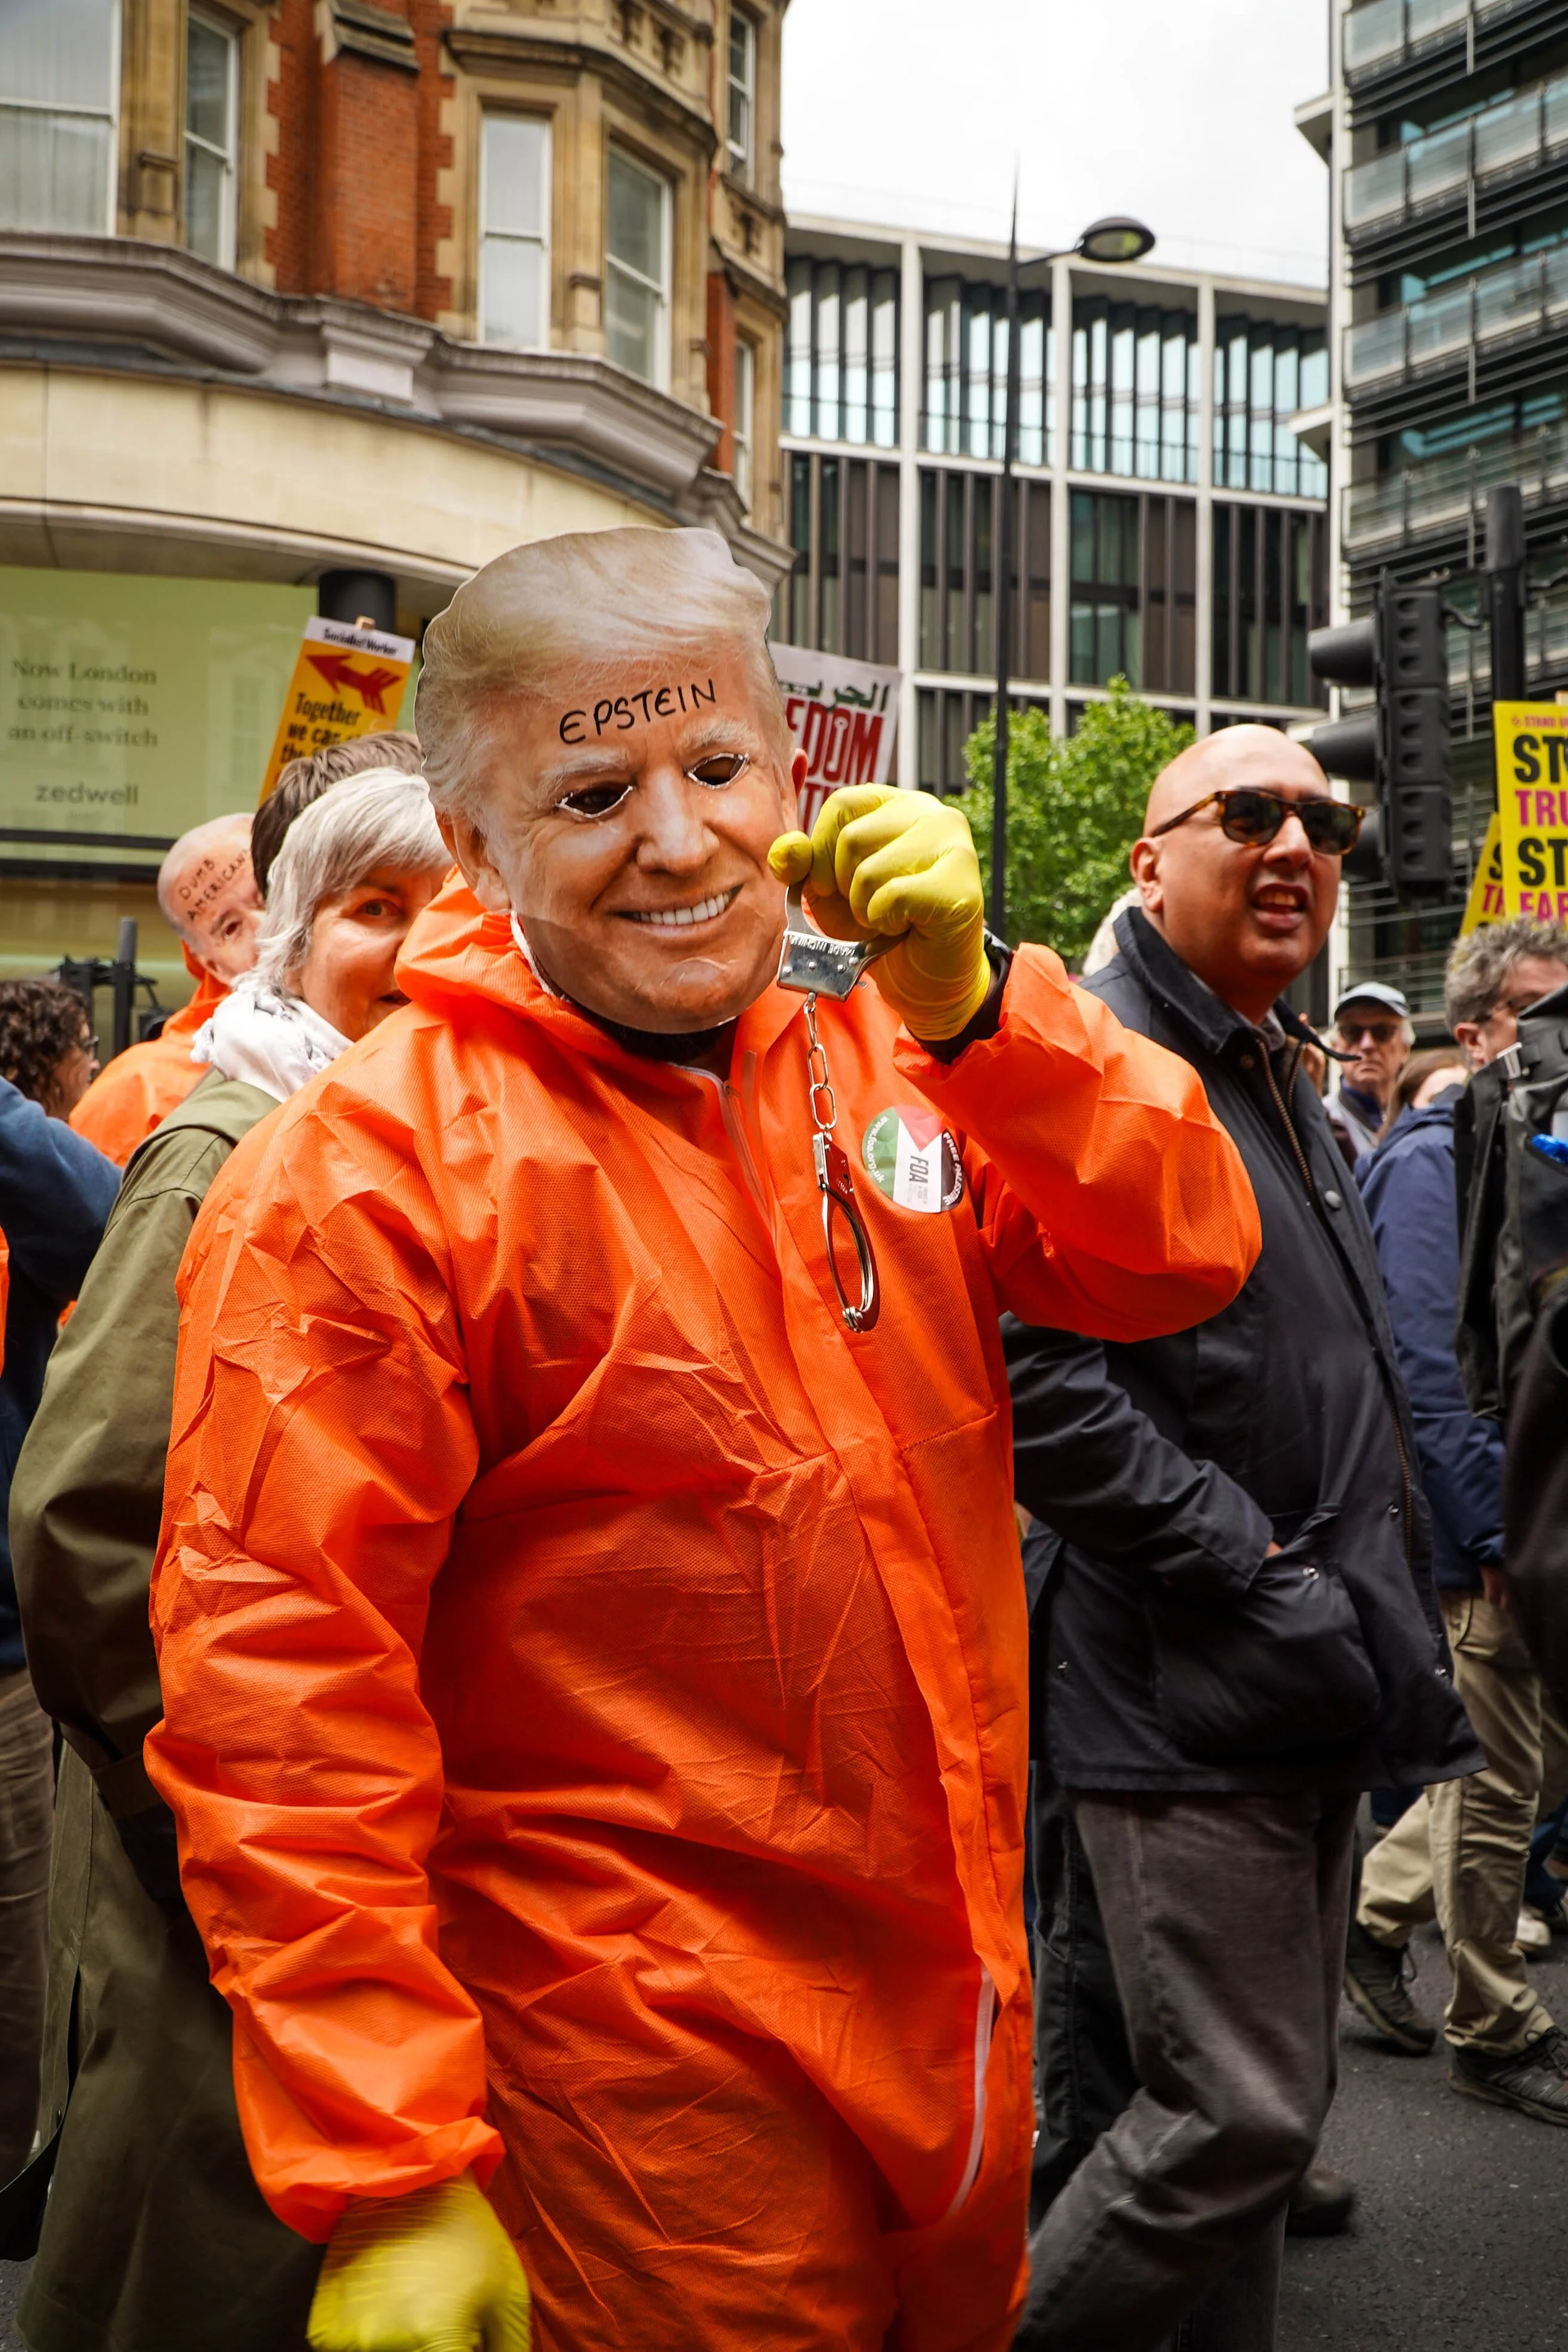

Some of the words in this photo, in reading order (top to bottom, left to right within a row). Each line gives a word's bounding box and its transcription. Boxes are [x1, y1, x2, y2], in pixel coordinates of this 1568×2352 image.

[69, 662, 157, 685] London
[18, 696, 92, 712] comes
[97, 694, 149, 716] with
[295, 692, 361, 726] Together
[559, 679, 716, 744] EPSTEIN
[9, 725, 36, 741] an
[288, 723, 307, 741] we
[1513, 734, 1568, 783] ST
[35, 781, 139, 806] zedwell
[179, 858, 215, 900] DUMB
[867, 1116, 889, 1184] www.foa.org.uk
[943, 1132, 960, 1162] FREE
[909, 1155, 929, 1184] FOA
[943, 1163, 963, 1206] PALESTINE
